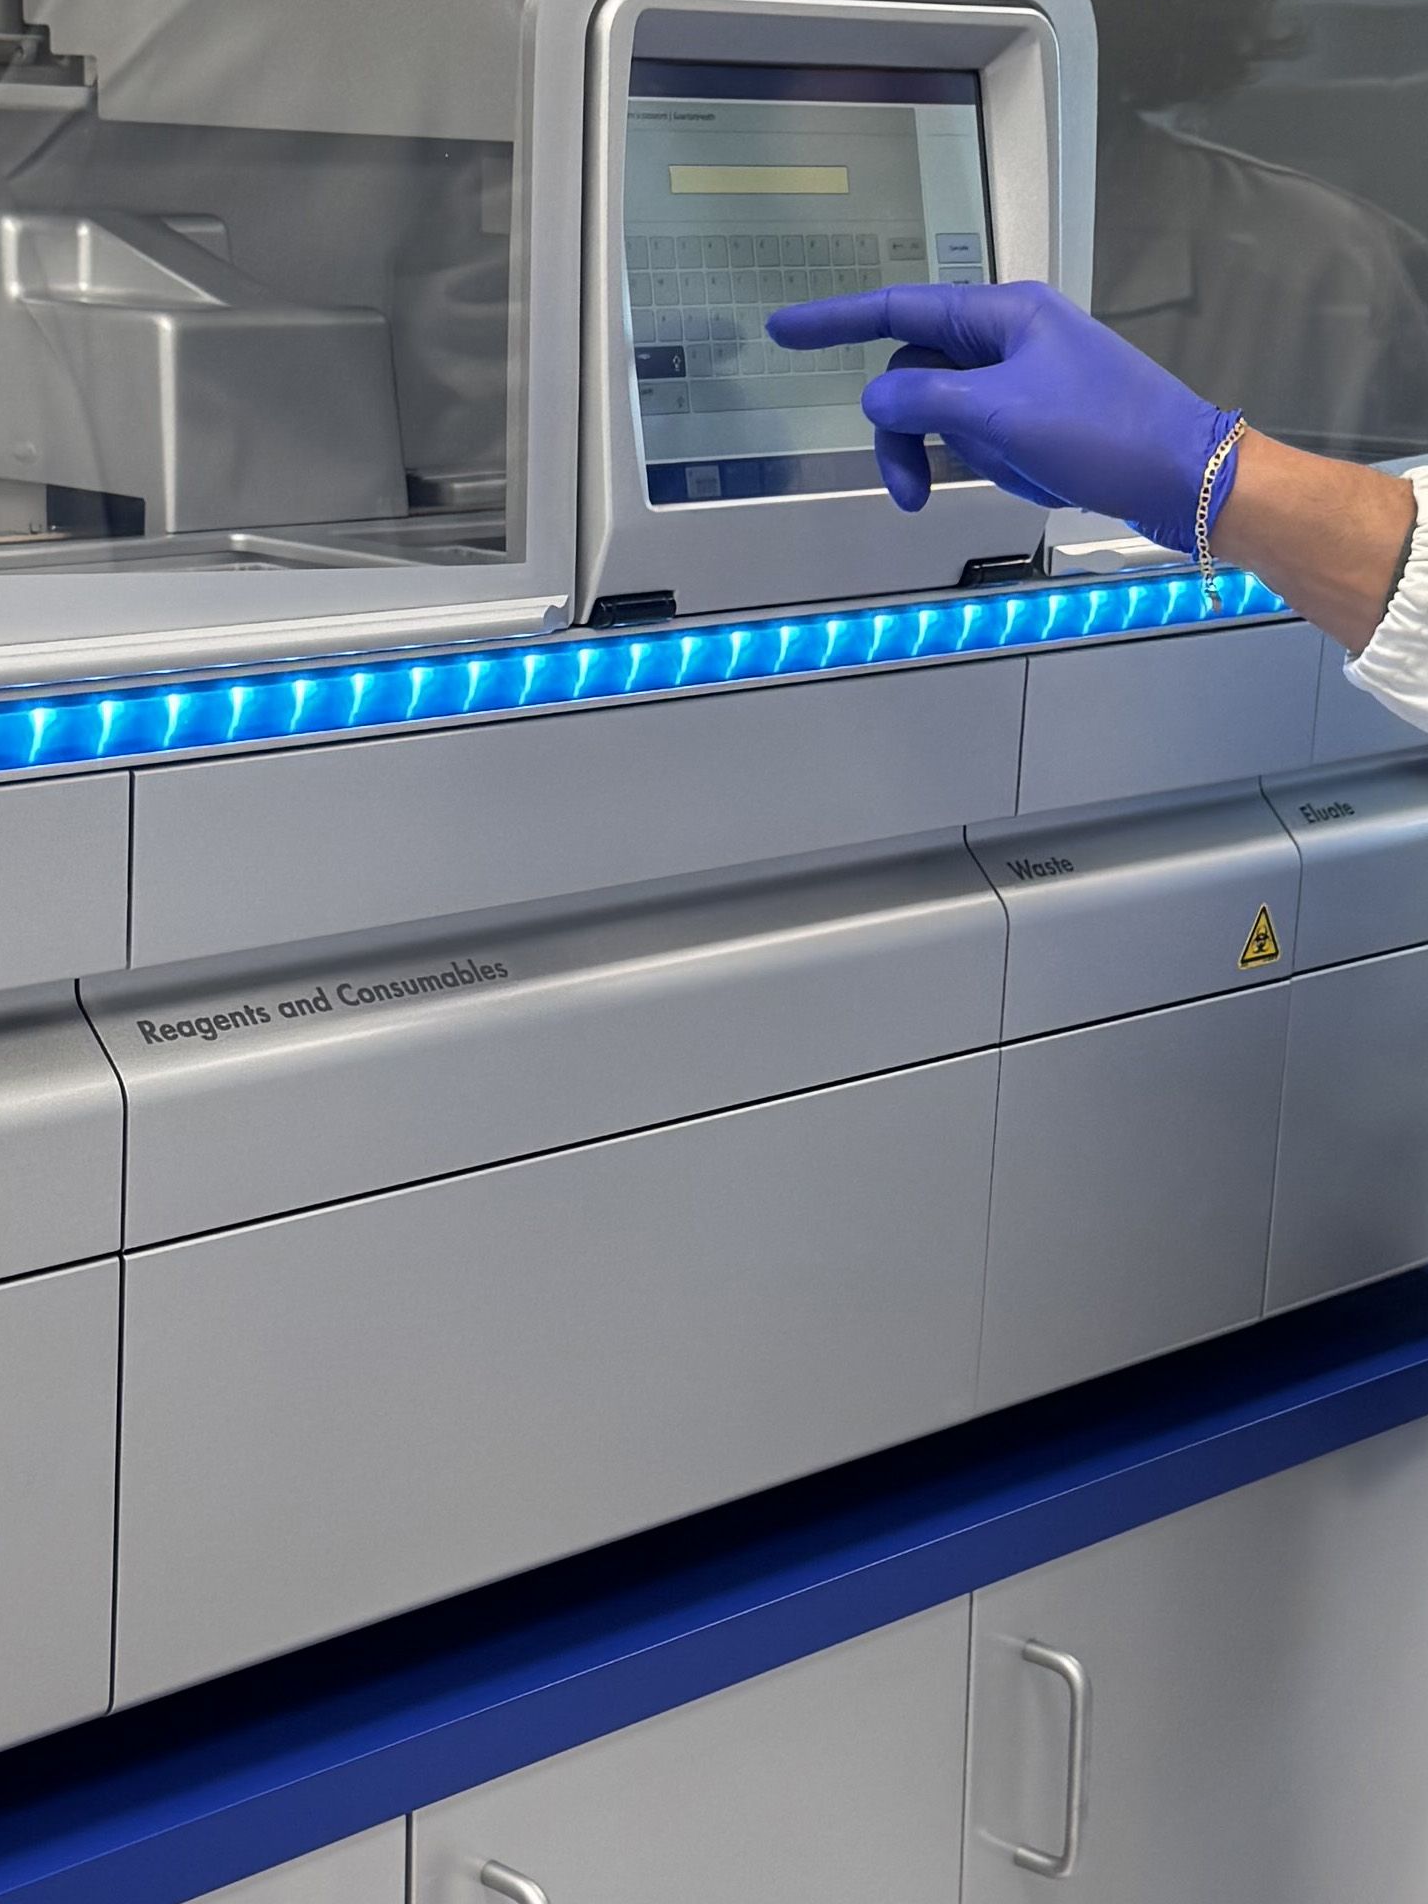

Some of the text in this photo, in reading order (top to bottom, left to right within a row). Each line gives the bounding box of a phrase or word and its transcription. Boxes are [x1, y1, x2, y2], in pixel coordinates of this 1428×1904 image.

[1299, 801, 1355, 824] Eluate
[1006, 857, 1074, 881] Waste
[137, 958, 509, 1044] Reagents and Consumables
